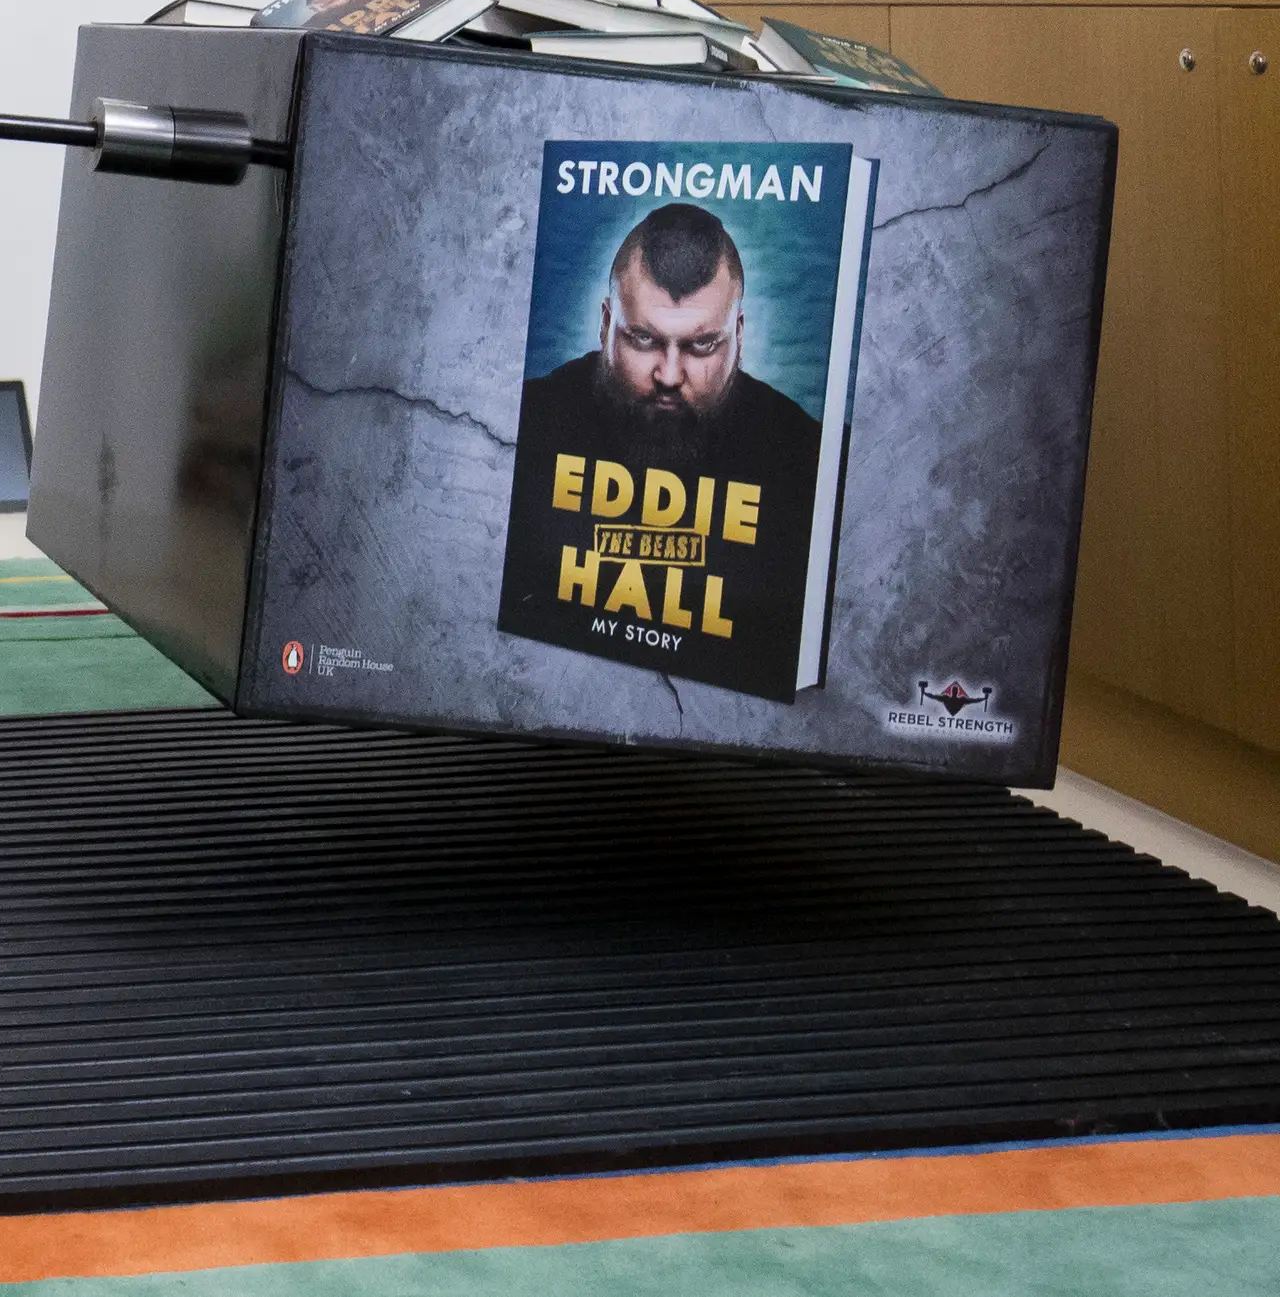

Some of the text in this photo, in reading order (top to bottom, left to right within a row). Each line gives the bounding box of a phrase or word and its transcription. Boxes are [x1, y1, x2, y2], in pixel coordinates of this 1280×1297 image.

[556, 160, 824, 203] STRONGMAN
[552, 453, 762, 545] EDDIE
[598, 531, 701, 560] THE BEAST
[557, 544, 734, 639] HALL
[591, 617, 683, 652] MY STORY
[318, 655, 394, 672] Random House
[320, 645, 362, 659] Penguin
[317, 666, 334, 677] UK
[888, 712, 934, 727] REBEL
[938, 716, 1013, 734] STRENGTH
